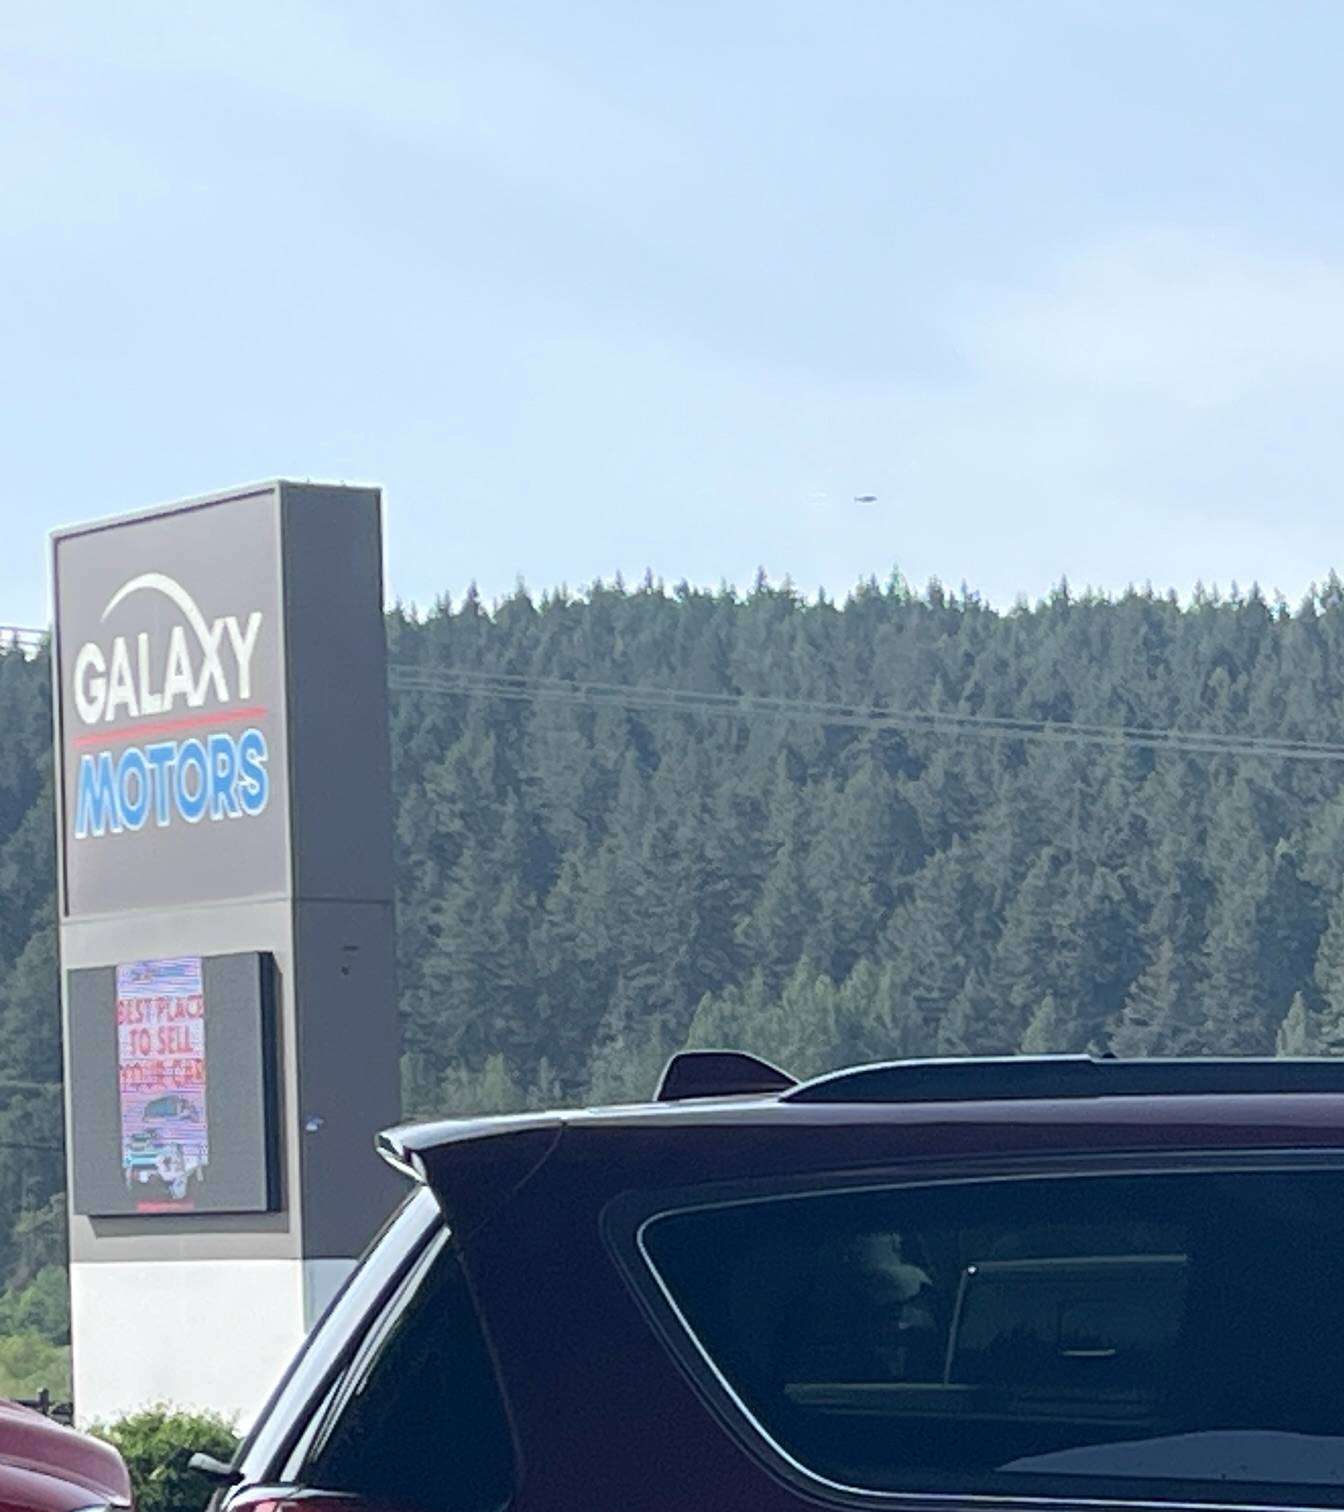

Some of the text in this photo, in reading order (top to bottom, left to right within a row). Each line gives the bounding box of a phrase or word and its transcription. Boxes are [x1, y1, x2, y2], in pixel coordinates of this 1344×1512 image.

[74, 611, 263, 724] GALAXY
[74, 727, 270, 840] MOTORS
[129, 1025, 193, 1057] TO SELL
